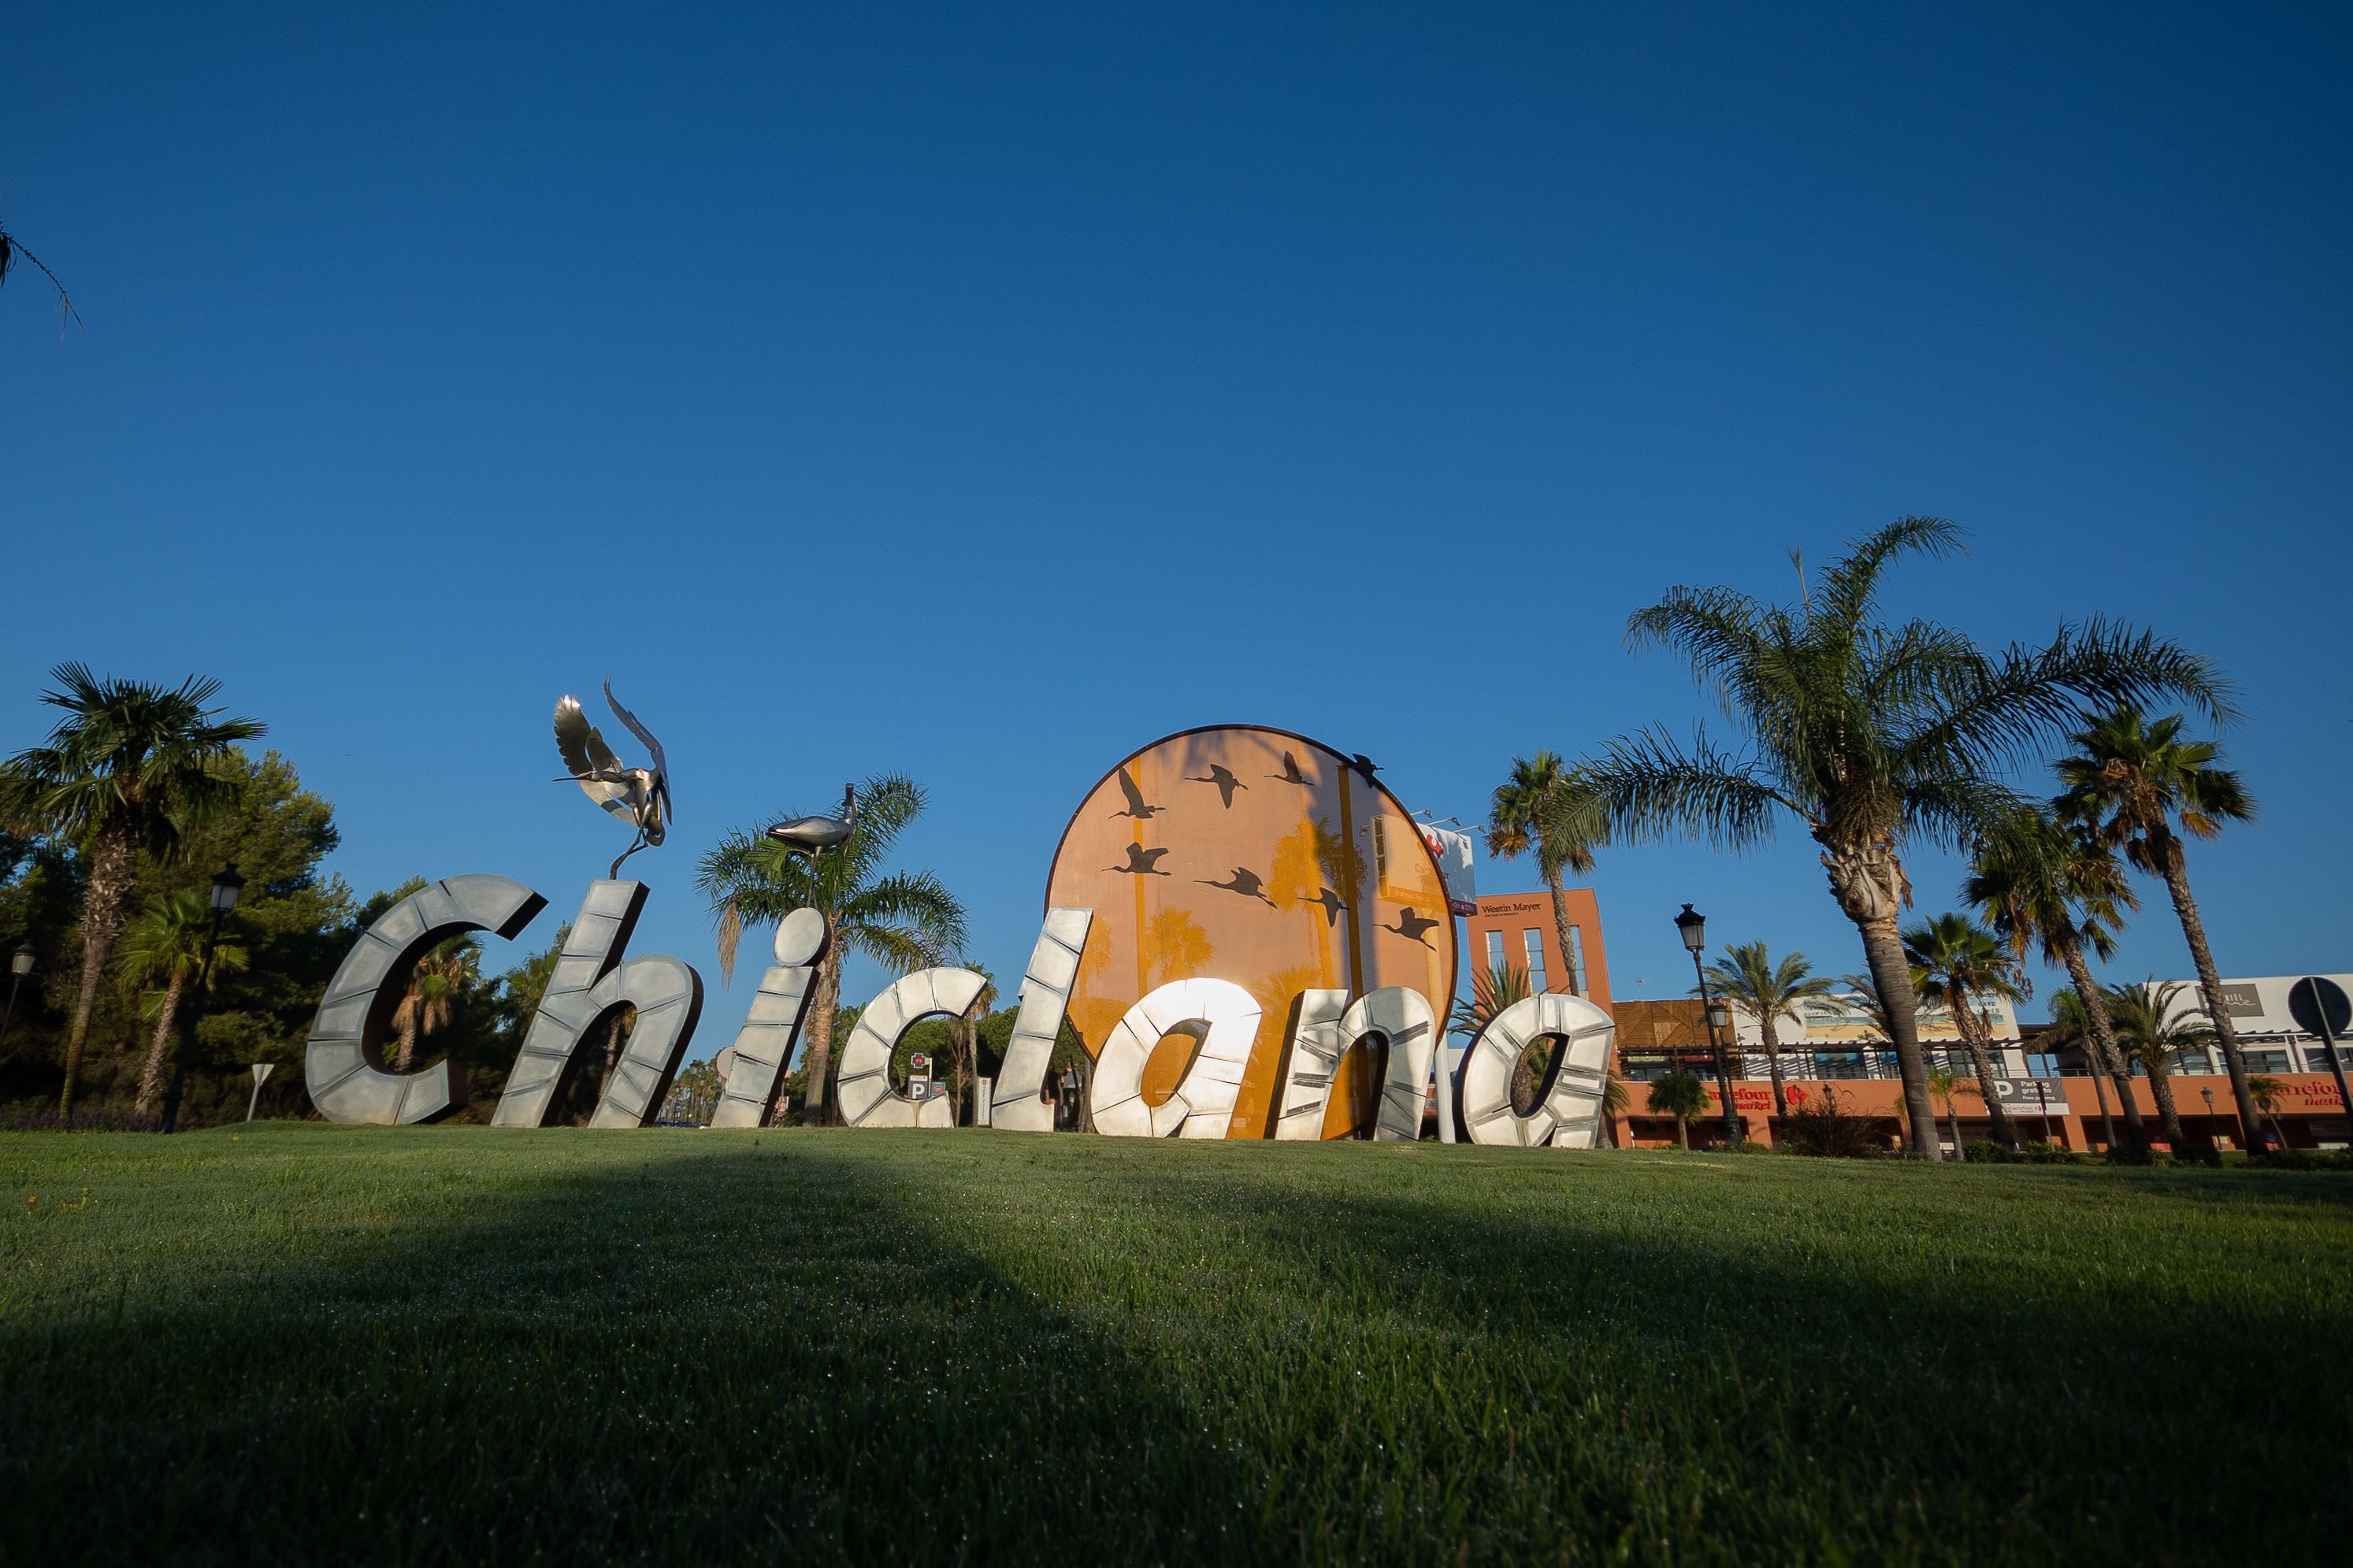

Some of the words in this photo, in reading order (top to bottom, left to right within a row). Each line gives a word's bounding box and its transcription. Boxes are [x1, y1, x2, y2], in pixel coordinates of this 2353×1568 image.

[1482, 904, 1512, 914] Westin
[1512, 903, 1542, 913] Mayer
[306, 873, 1616, 1151] Chiclana
[912, 1083, 925, 1099] P
